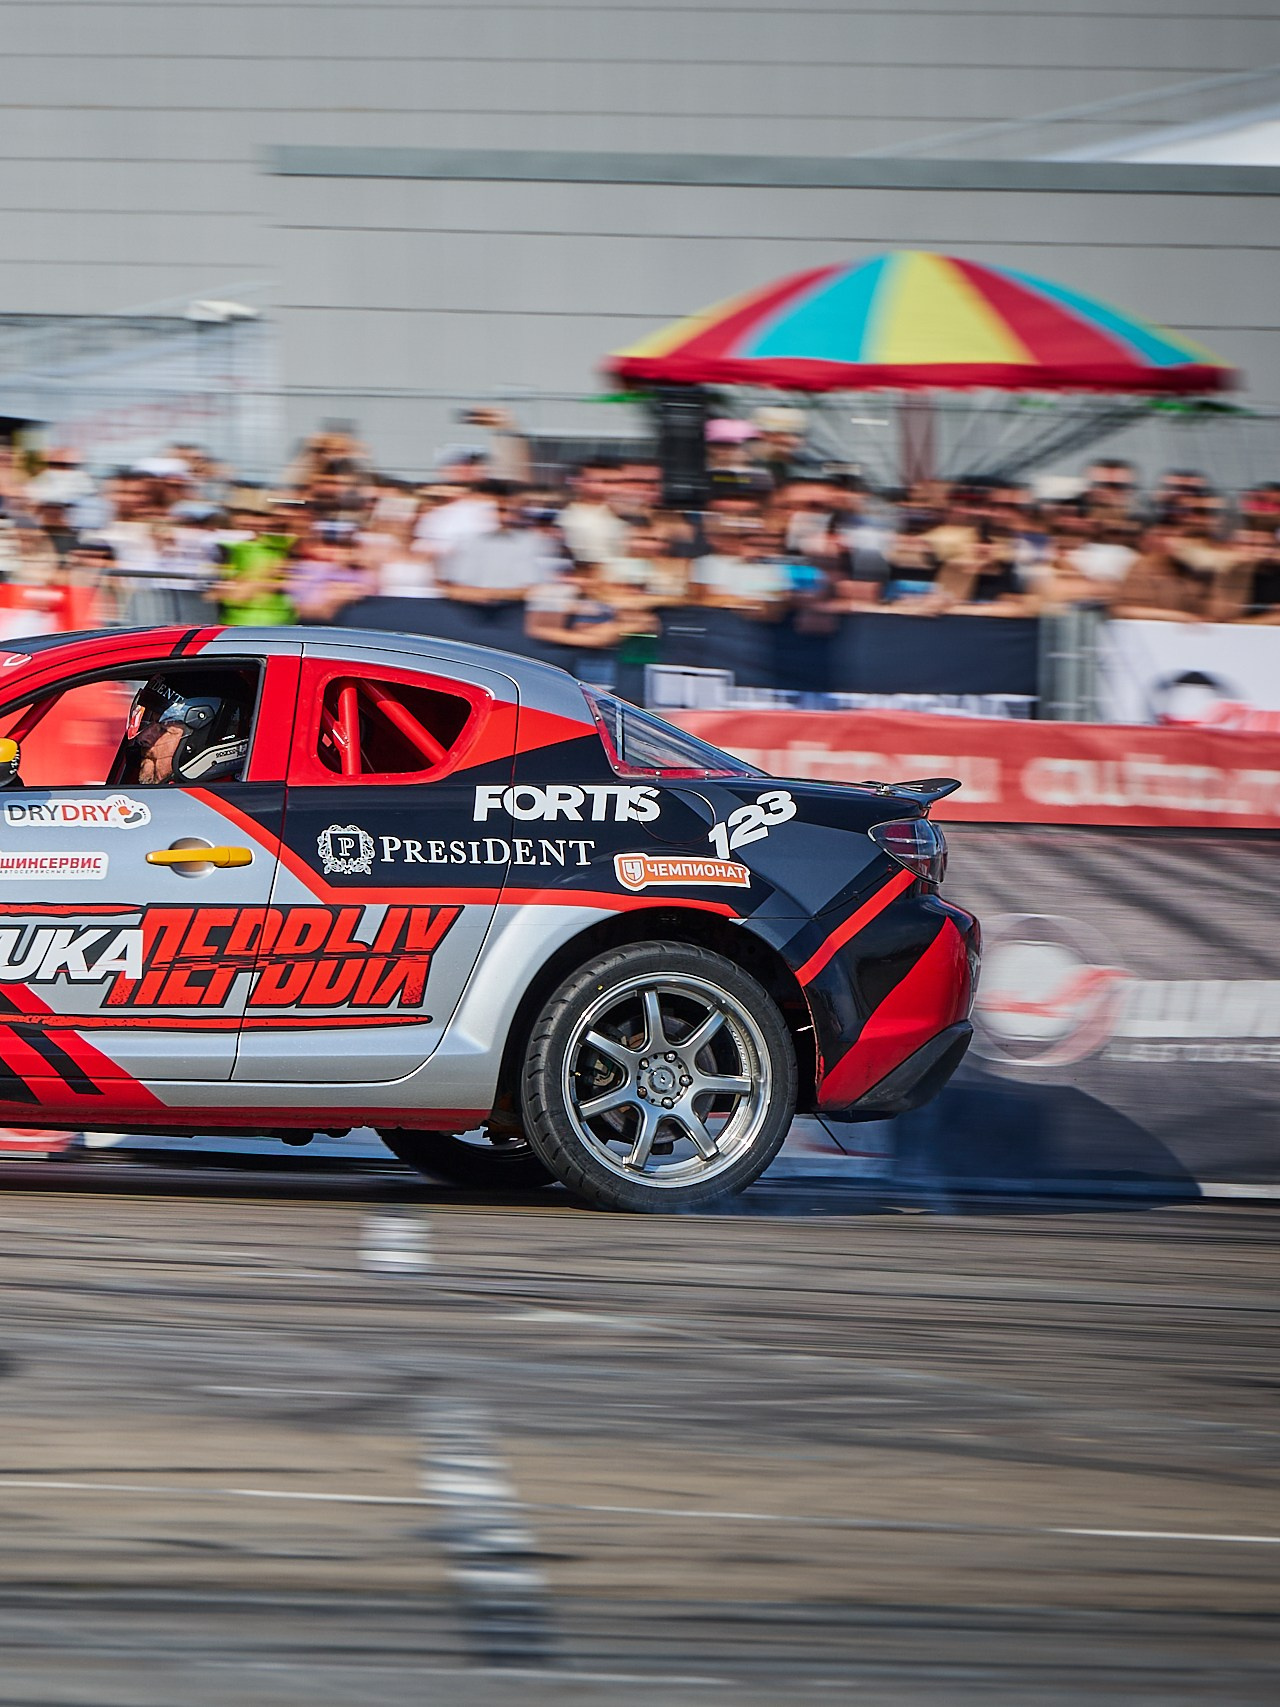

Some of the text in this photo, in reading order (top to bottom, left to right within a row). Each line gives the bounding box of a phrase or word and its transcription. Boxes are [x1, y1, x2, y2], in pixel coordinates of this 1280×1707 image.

[473, 785, 661, 822] FORTIS
[7, 804, 113, 822] DRYDRY
[708, 790, 798, 860] 123
[0, 857, 102, 869] ШИНСЕРВИС
[646, 863, 744, 879] ЧЕМПИОНАТ
